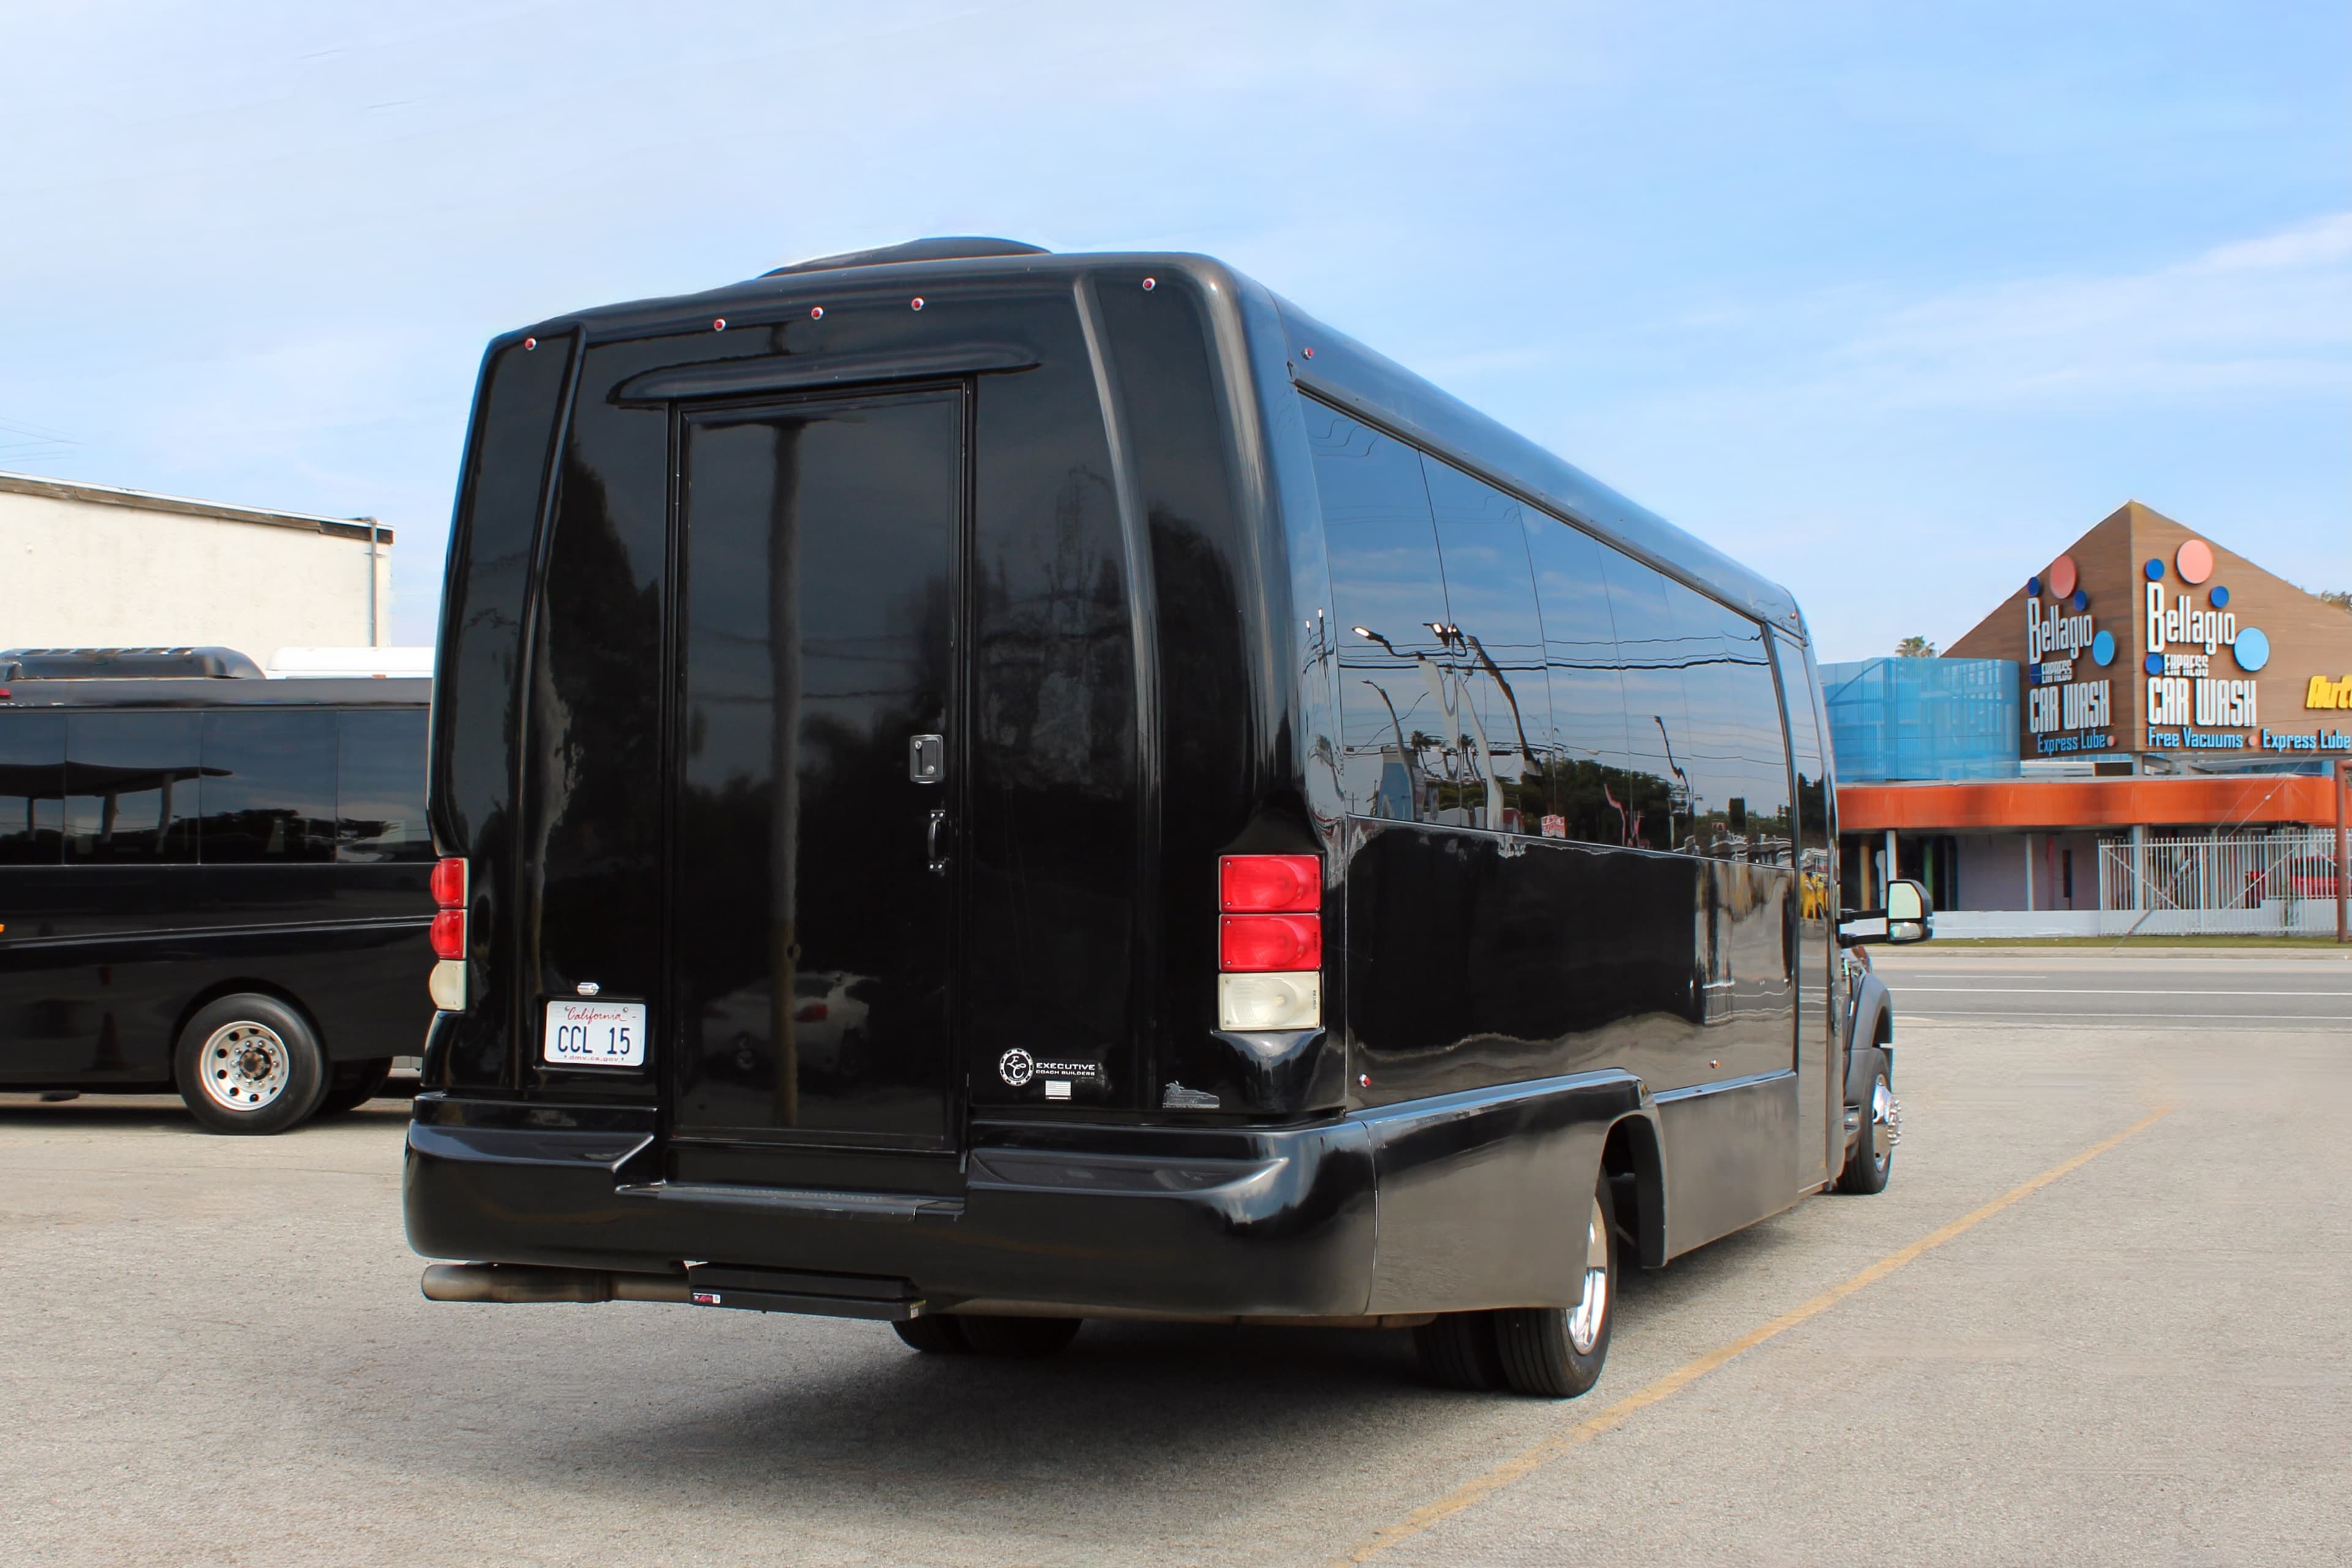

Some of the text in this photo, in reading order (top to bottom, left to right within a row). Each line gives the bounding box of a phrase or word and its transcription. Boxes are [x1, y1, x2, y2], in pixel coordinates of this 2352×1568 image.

[2027, 597, 2093, 665] Bellagio
[2147, 582, 2235, 655] Bellagio
[2041, 659, 2073, 684] EXPRESS
[2164, 654, 2209, 677] EXPRESS
[2029, 679, 2110, 734] CAR WASH
[2147, 677, 2257, 726] CAR WASH
[2305, 675, 2352, 709] Aut
[2037, 728, 2106, 756] Express Lube
[2148, 726, 2351, 753] Free Vacuums Express Lube
[567, 1006, 627, 1025] California
[558, 1025, 631, 1055] CCL 15
[1036, 1062, 1096, 1071] EXECUTIVE
